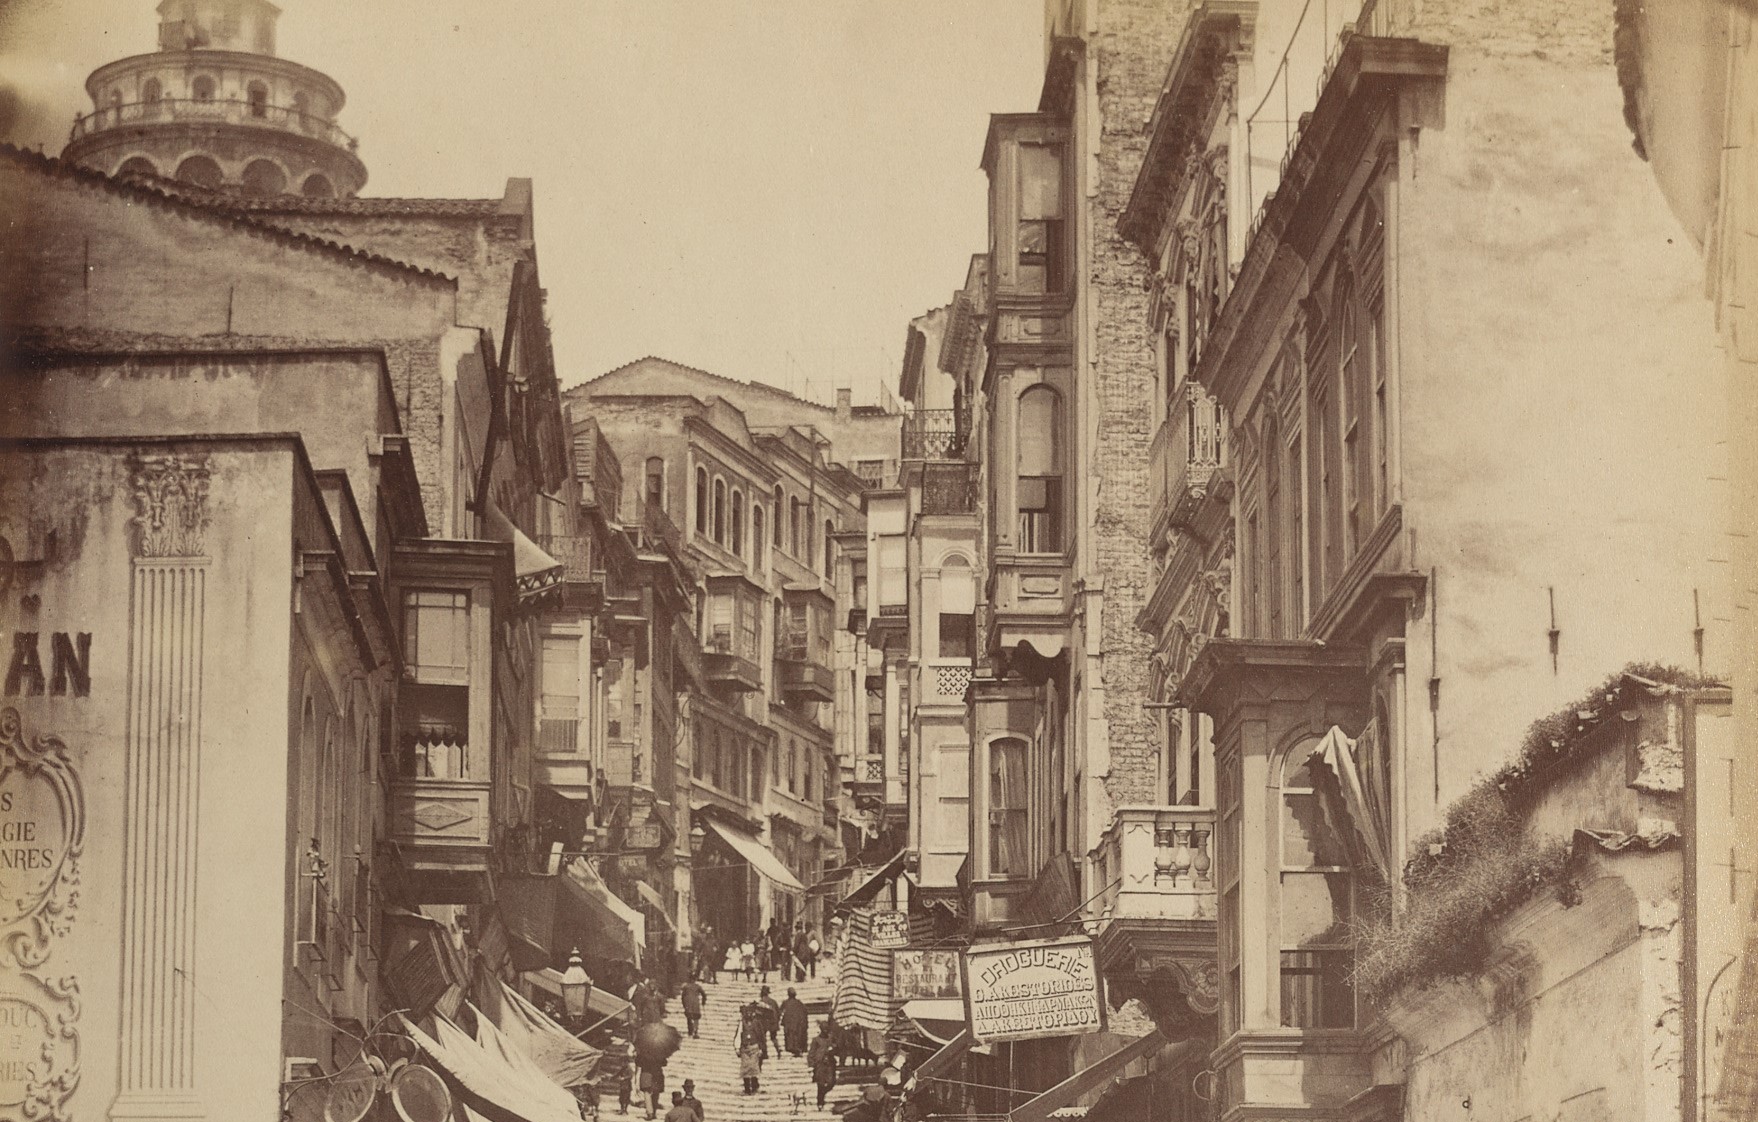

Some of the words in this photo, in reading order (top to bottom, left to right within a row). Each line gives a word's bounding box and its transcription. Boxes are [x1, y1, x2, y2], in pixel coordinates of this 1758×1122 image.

[2, 821, 36, 842] GIE
[1, 848, 54, 871] NRES
[980, 948, 1089, 987] DROGUERIE
